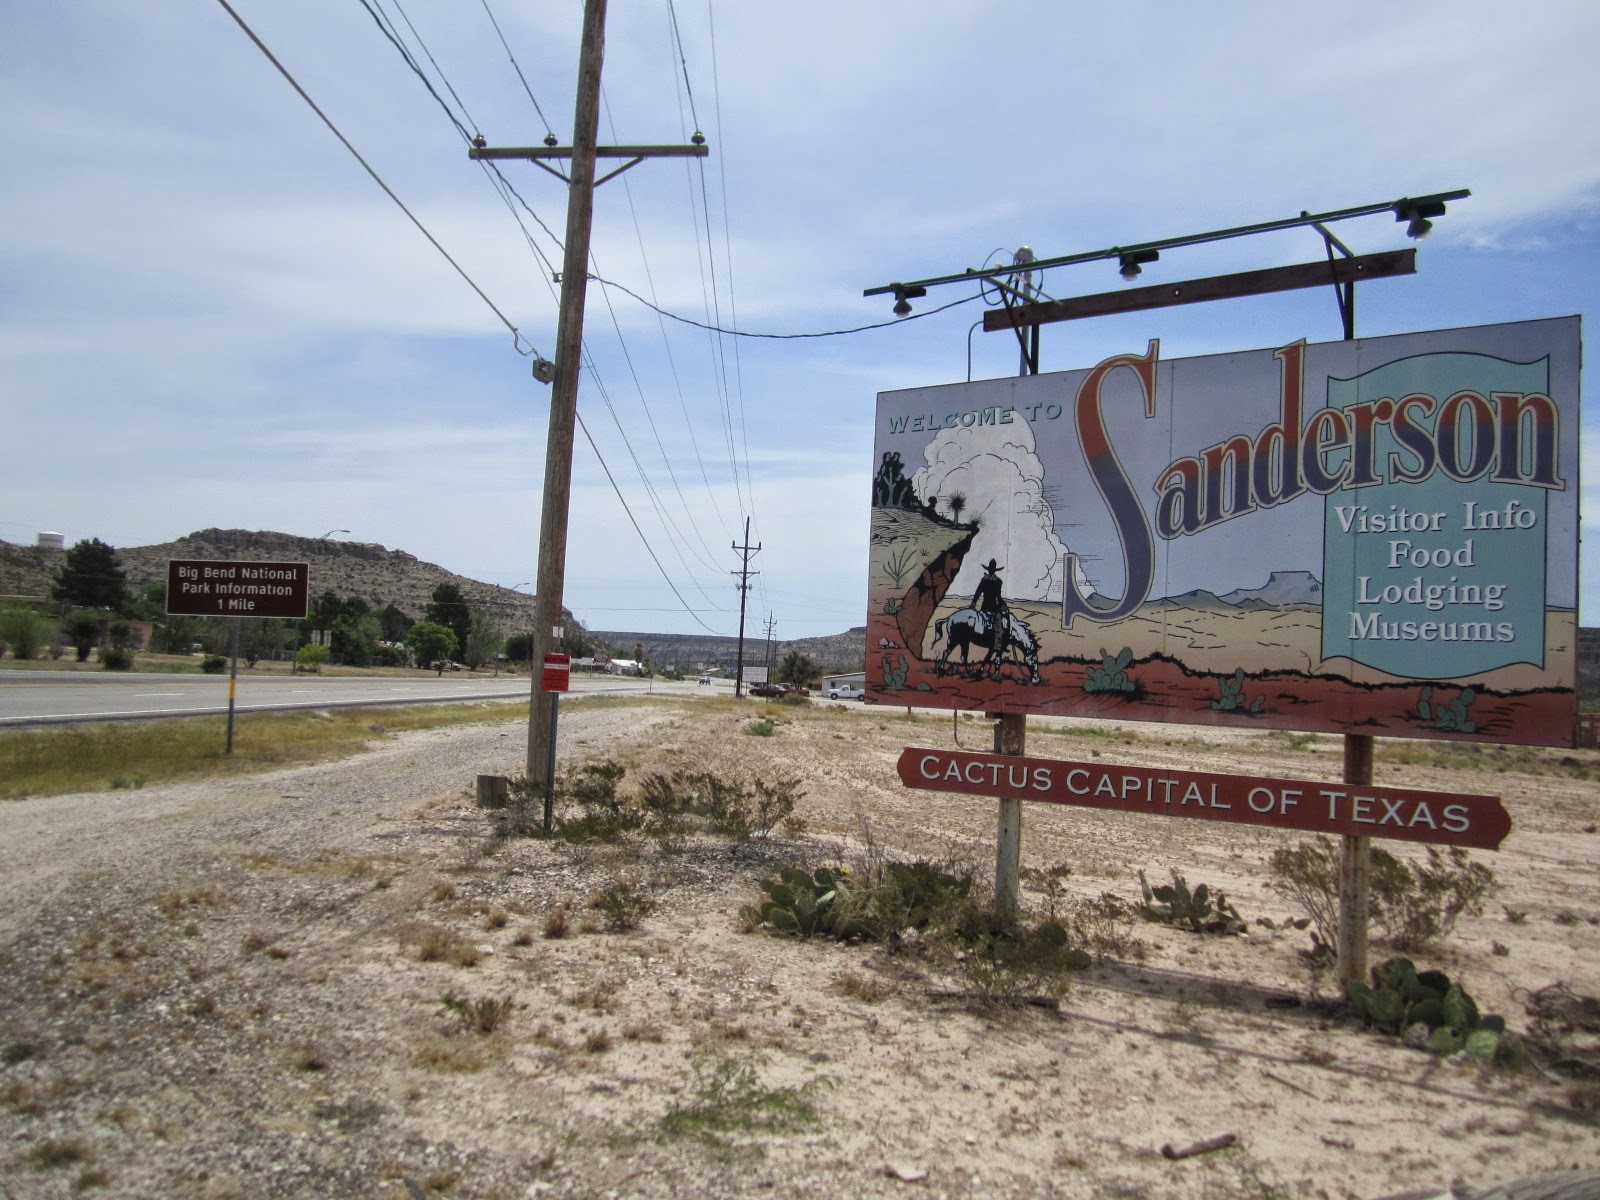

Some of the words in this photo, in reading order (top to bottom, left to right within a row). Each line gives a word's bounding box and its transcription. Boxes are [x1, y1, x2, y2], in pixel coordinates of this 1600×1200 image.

[889, 405, 1015, 434] WELCOME
[1024, 402, 1063, 422] TO
[1061, 337, 1566, 630] Sanderson
[1334, 504, 1448, 535] Visitor
[1463, 499, 1537, 531] Info
[1387, 539, 1475, 570] Food
[179, 567, 198, 580] Big
[205, 567, 236, 579] Bend
[242, 568, 297, 580] National
[182, 583, 210, 594] Park
[215, 583, 293, 596] Information
[218, 599, 223, 610] 1
[229, 599, 256, 610] Mile
[1358, 577, 1507, 610] Lodging
[1349, 612, 1515, 644] Museums
[919, 755, 1053, 792] CACTUS
[1066, 768, 1232, 810] CAPITAL
[1248, 787, 1304, 815] OF
[1320, 791, 1471, 833] TEXAS
